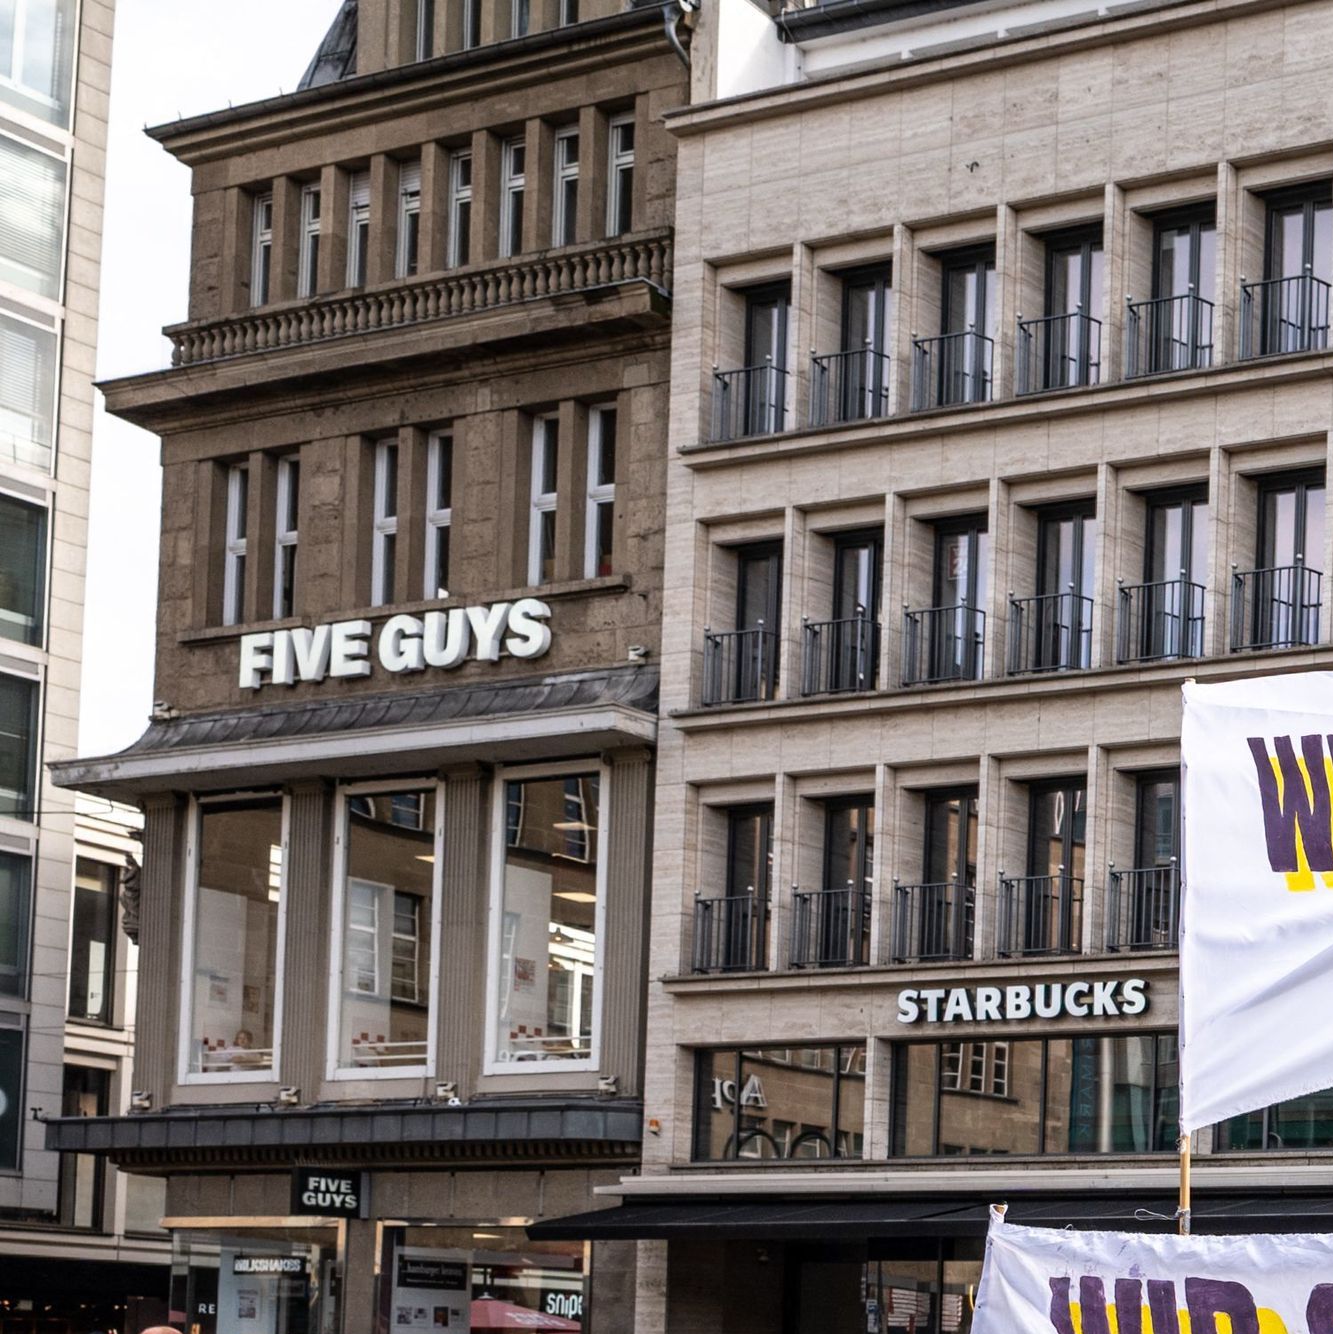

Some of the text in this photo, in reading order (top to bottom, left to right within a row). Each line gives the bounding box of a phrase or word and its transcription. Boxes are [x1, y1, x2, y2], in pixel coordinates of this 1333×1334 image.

[239, 598, 552, 689] FIVE GUYS
[897, 978, 1149, 1023] STARBUCKS
[301, 1191, 358, 1209] GUYS
[308, 1176, 352, 1193] FIVE
